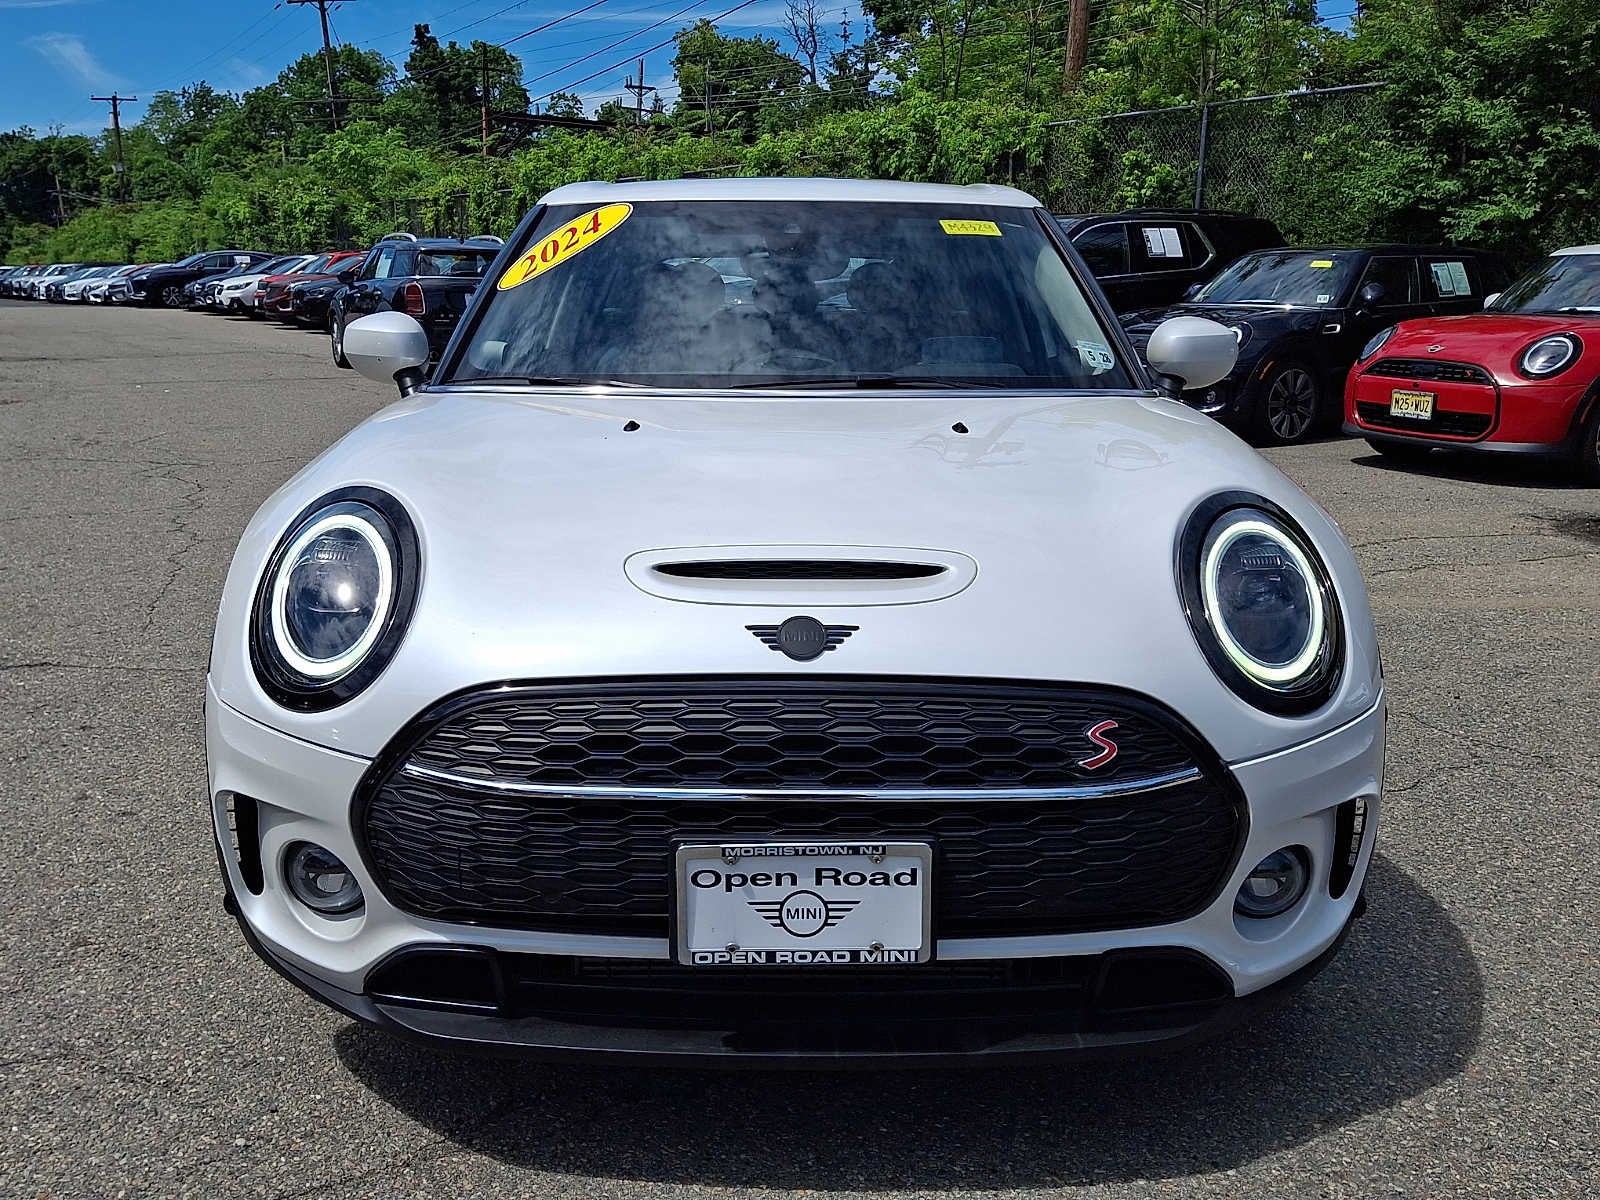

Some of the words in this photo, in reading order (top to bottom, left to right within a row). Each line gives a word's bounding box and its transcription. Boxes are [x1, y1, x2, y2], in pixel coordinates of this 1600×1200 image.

[521, 212, 602, 280] 2024
[1087, 350, 1096, 361] 5
[783, 630, 820, 642] MINI
[1078, 720, 1118, 769] S
[860, 846, 883, 855] NJ
[690, 869, 797, 892] Open
[815, 867, 918, 887] Road
[786, 908, 822, 920] MINI
[694, 951, 766, 964] OPEN
[776, 951, 850, 964] ROAD
[860, 950, 916, 963] MINI
